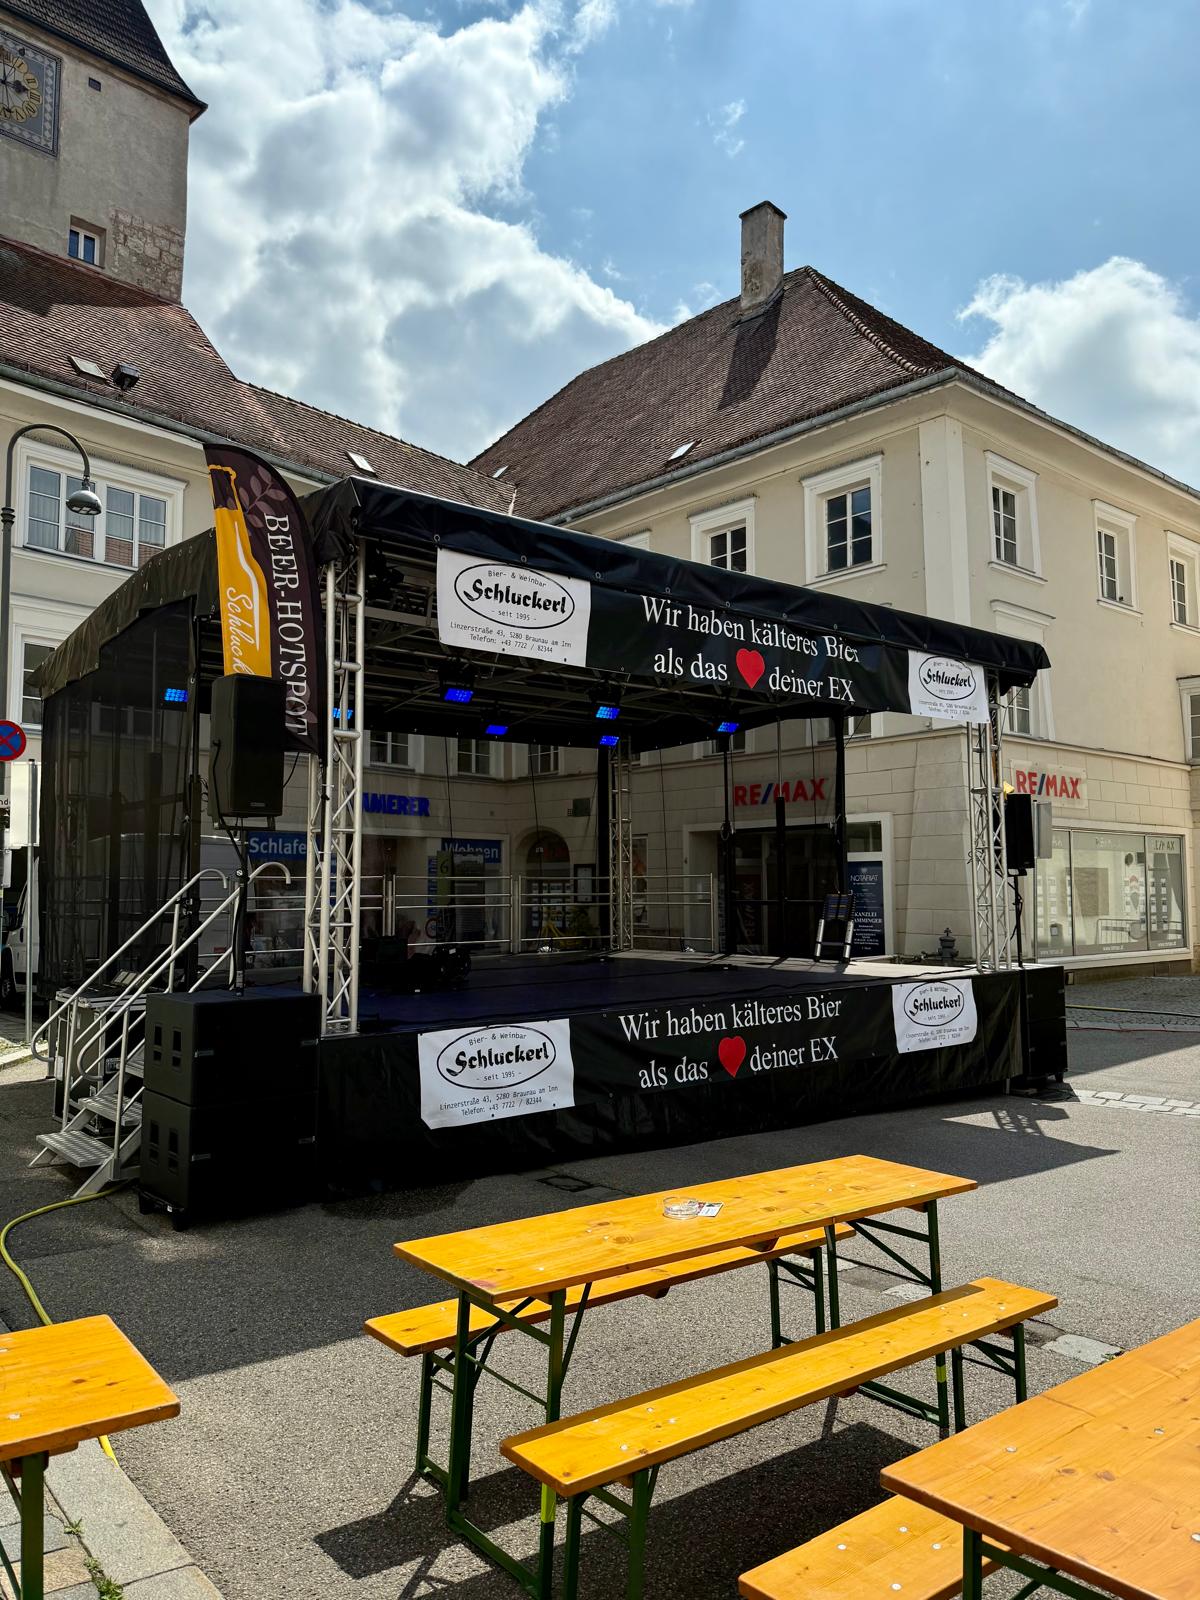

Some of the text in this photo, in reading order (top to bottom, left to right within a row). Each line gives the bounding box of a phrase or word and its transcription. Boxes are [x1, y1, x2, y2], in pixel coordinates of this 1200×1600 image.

[487, 569, 507, 578] Bier-
[519, 574, 547, 588] Weinbar
[463, 578, 566, 614] Schluckerl
[264, 512, 309, 736] BEER-HOTSPOT
[498, 609, 513, 618] seit
[515, 612, 531, 621] 1995
[640, 594, 861, 663] Wir haben kälteres Bier
[226, 586, 256, 676] Schluck
[450, 621, 494, 635] Linzerstraße
[496, 629, 506, 638] 43,
[509, 631, 523, 640] 5280
[525, 634, 549, 644] Braunau
[562, 640, 572, 648] Inn
[470, 633, 497, 645] Telefon:
[500, 640, 512, 648] +43
[514, 641, 528, 649] 7722
[653, 648, 856, 703] als das deiner EX
[922, 668, 972, 688] Schluckerl
[735, 778, 826, 806] RE/MAX
[1015, 769, 1080, 800] RE/MAX
[249, 838, 308, 856] Schlafe
[618, 994, 842, 1042] Wir haben kälteres Bier
[909, 994, 961, 1016] Schluckerl
[468, 1036, 487, 1046] Bier-
[500, 1032, 527, 1040] Weinbar
[446, 1042, 549, 1077] Schluckerl
[638, 1036, 839, 1089] als das deiner EX
[483, 1074, 499, 1082] seit
[502, 1071, 516, 1079] 1995
[440, 1097, 480, 1111] Linzerstraße
[482, 1095, 492, 1104] 43,
[496, 1092, 510, 1101] 5280
[513, 1090, 537, 1099] Braunau
[548, 1085, 558, 1093] Inn
[461, 1106, 486, 1117] Telefon:
[488, 1104, 499, 1112] +43
[502, 1101, 515, 1109] 7722
